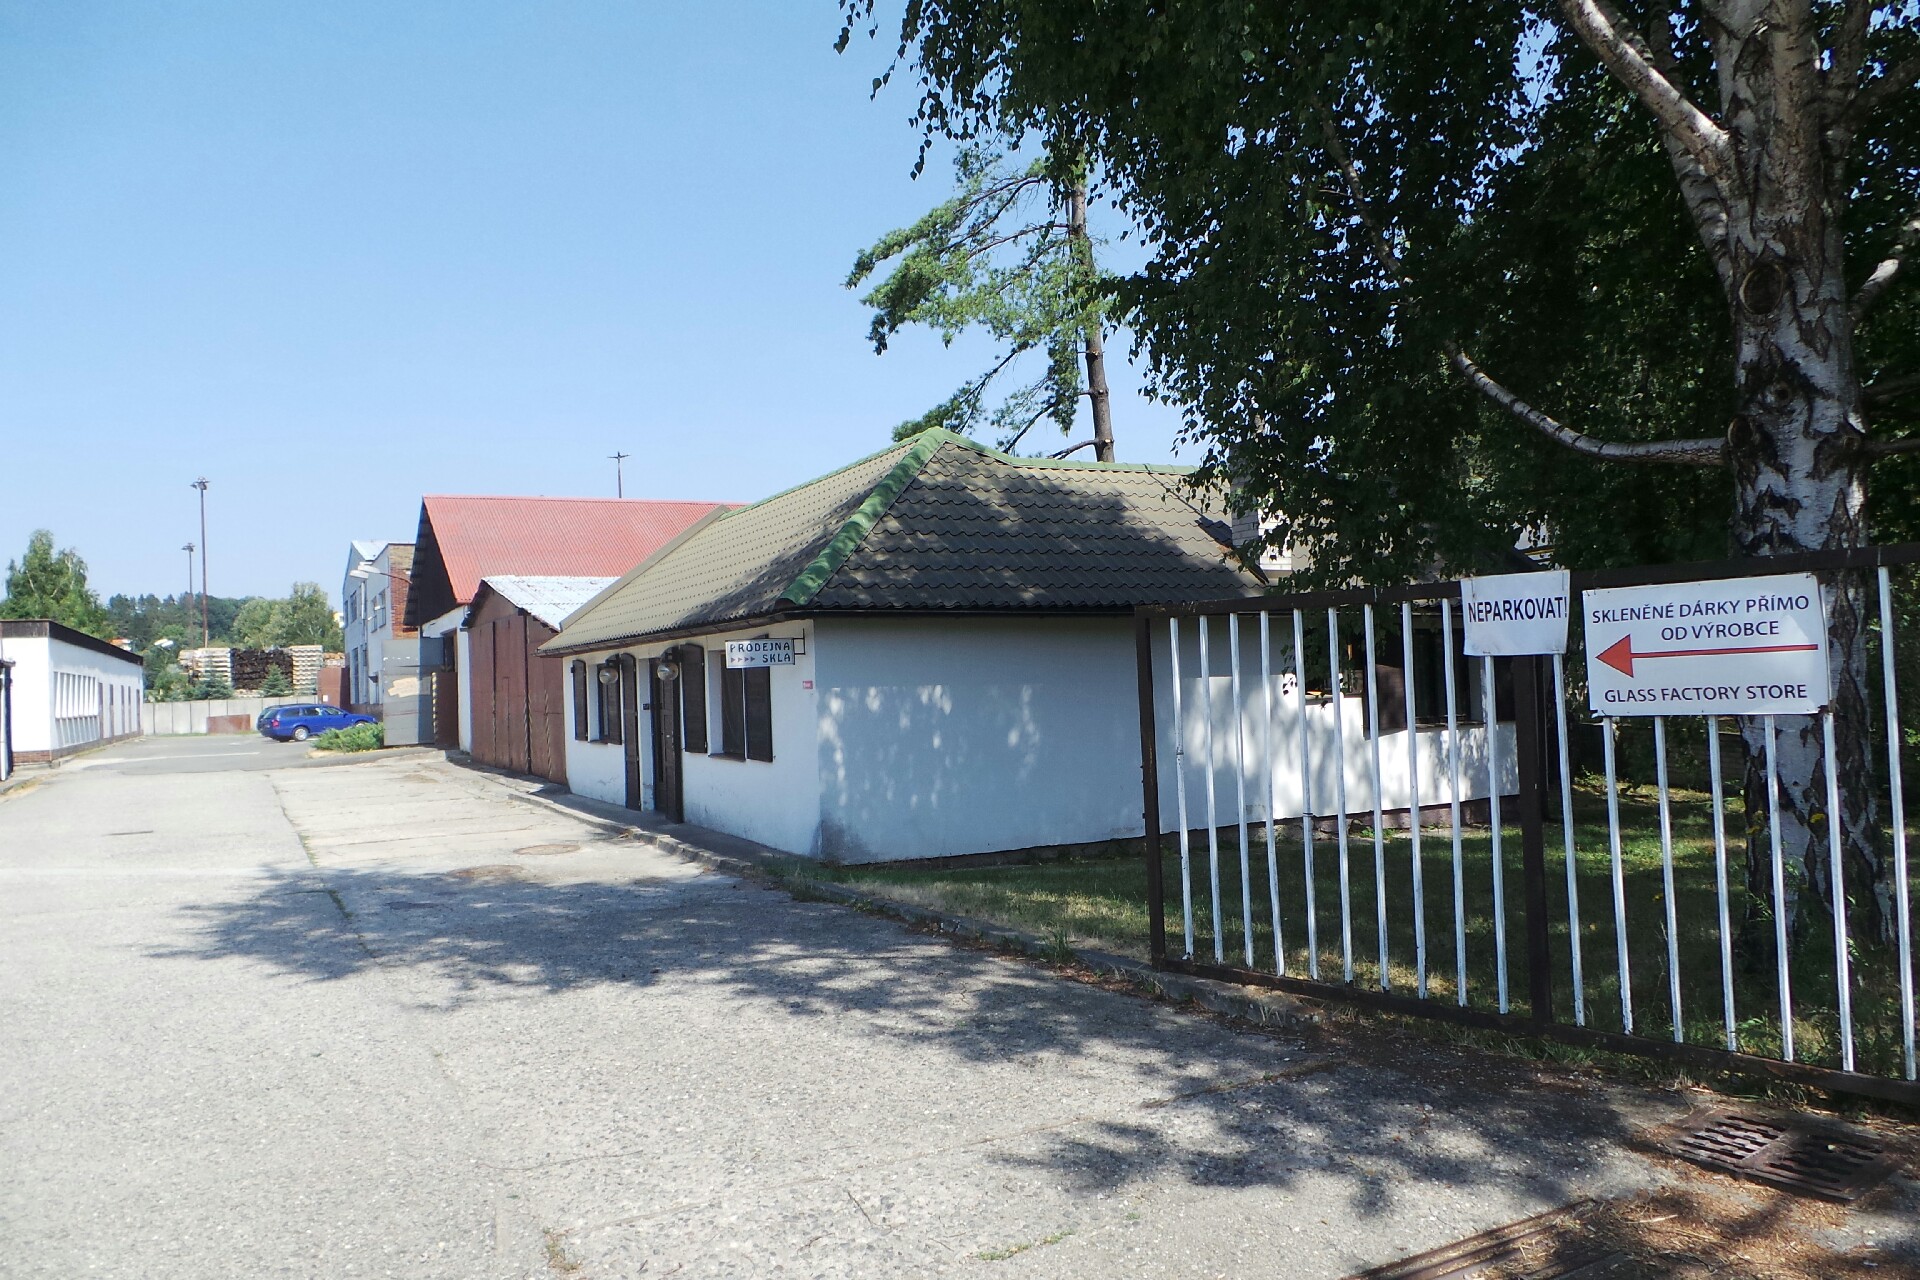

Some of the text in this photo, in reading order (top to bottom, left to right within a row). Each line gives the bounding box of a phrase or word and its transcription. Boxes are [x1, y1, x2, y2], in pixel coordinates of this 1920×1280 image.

[1467, 596, 1569, 624] NEPARKOVAT!
[1592, 593, 1810, 624] SKLENĚNÉ DÁRKY PŘÍMO
[1661, 620, 1780, 641] OD VÝROBCE
[729, 642, 791, 653] PRODEJNA
[762, 653, 791, 663] SKLA
[1603, 684, 1808, 704] GLASS FACTORY STORE
